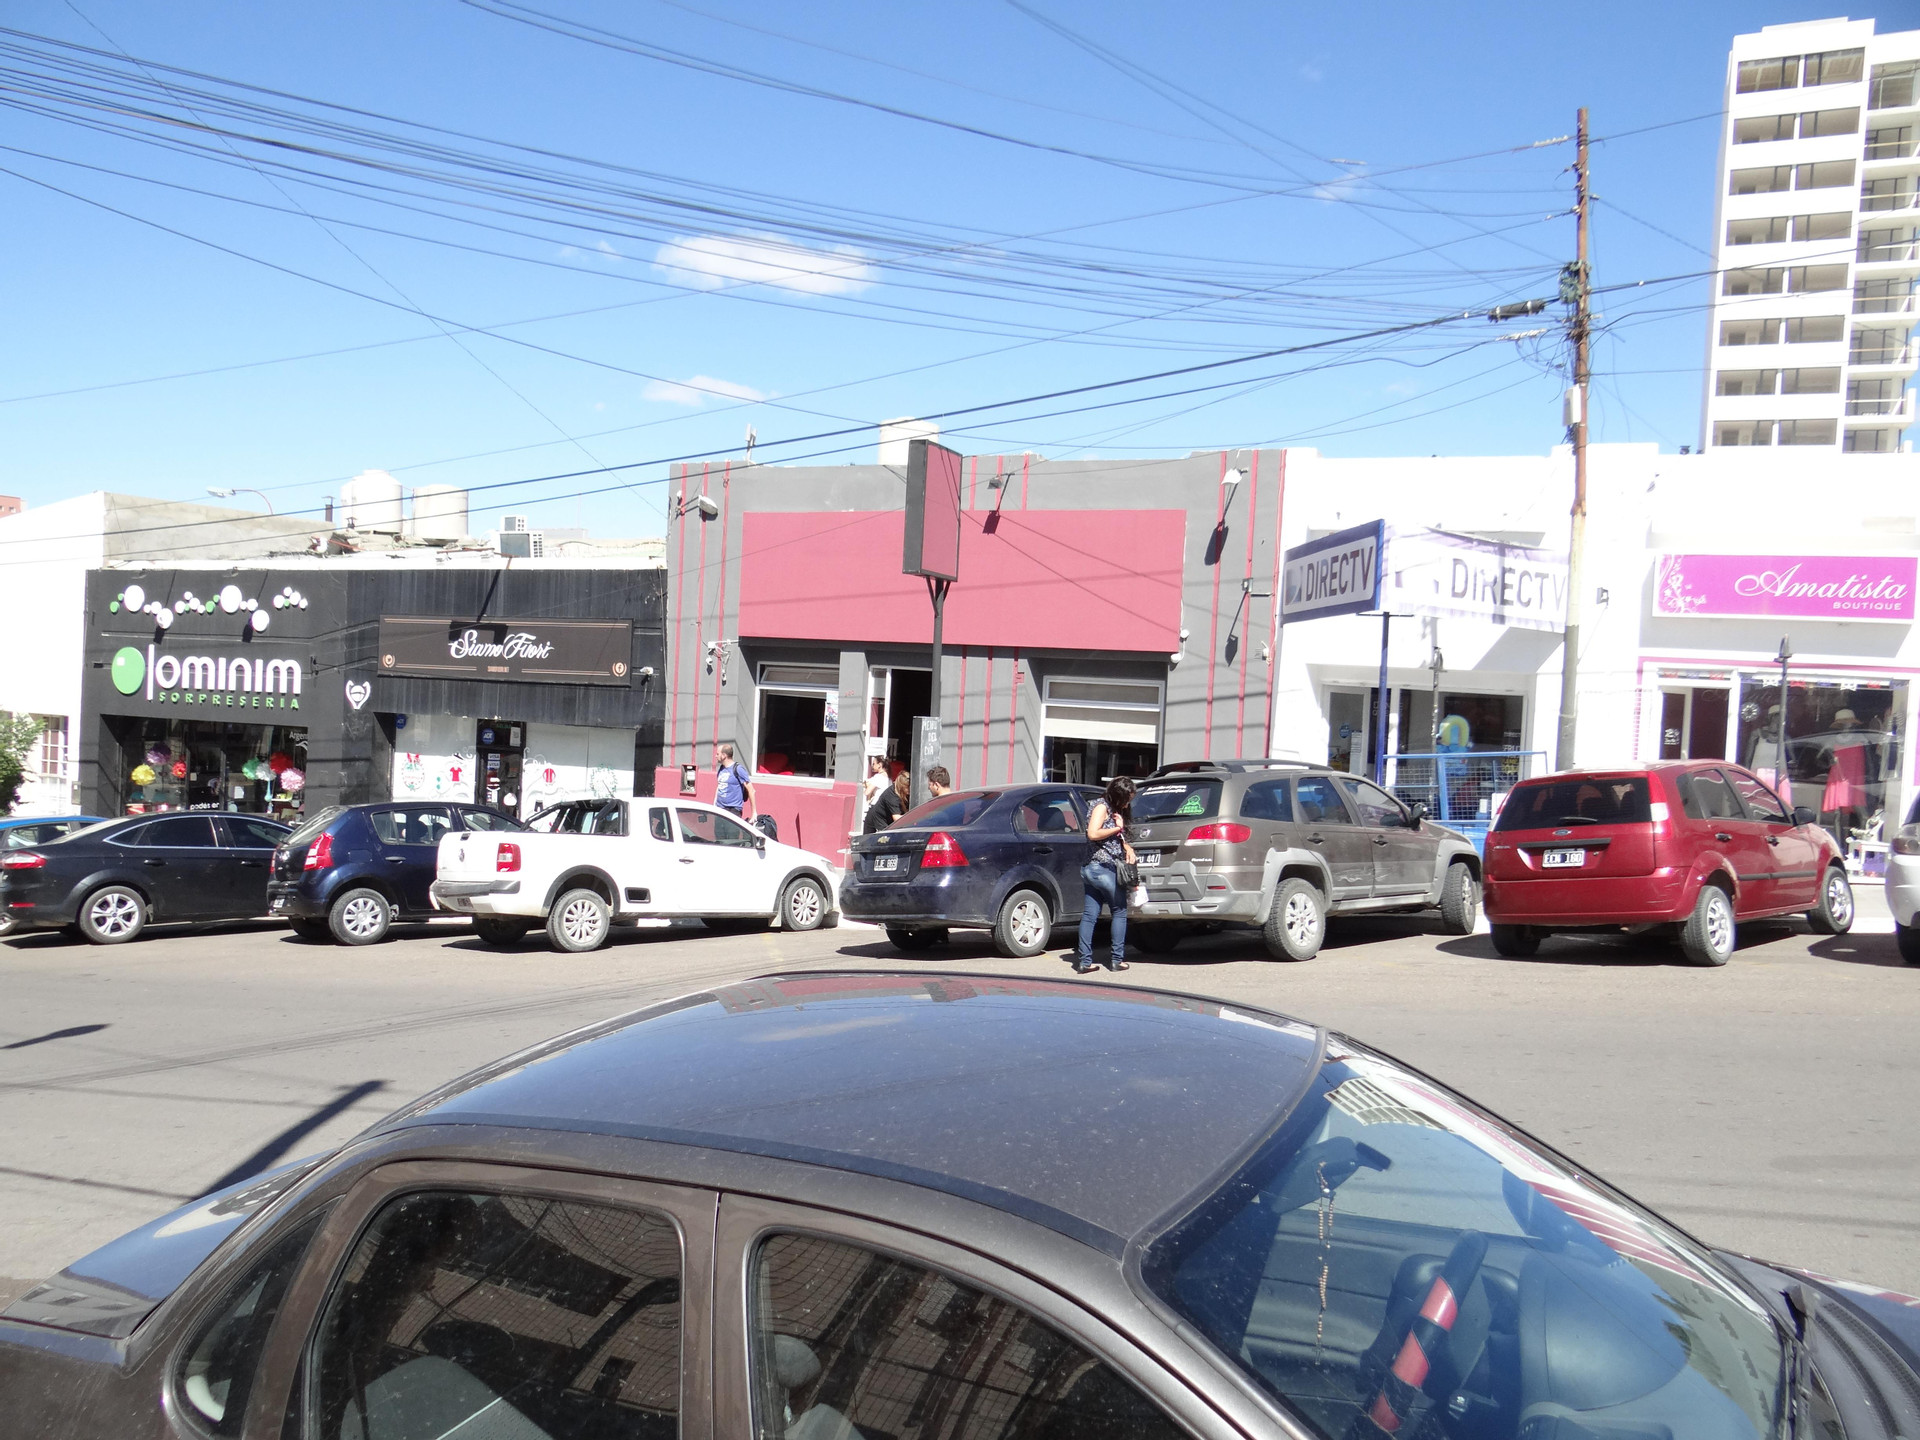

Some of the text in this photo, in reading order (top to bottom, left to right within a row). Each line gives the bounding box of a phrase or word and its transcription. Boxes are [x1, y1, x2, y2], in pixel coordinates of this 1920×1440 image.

[1305, 546, 1375, 602] DIRECTV
[1451, 557, 1567, 612] DIRECTV
[1734, 563, 1908, 600] Amatista
[1832, 601, 1903, 611] BOUTIQUE
[448, 629, 555, 660] Siamo Fuori
[158, 691, 300, 710] SORPRESERIA
